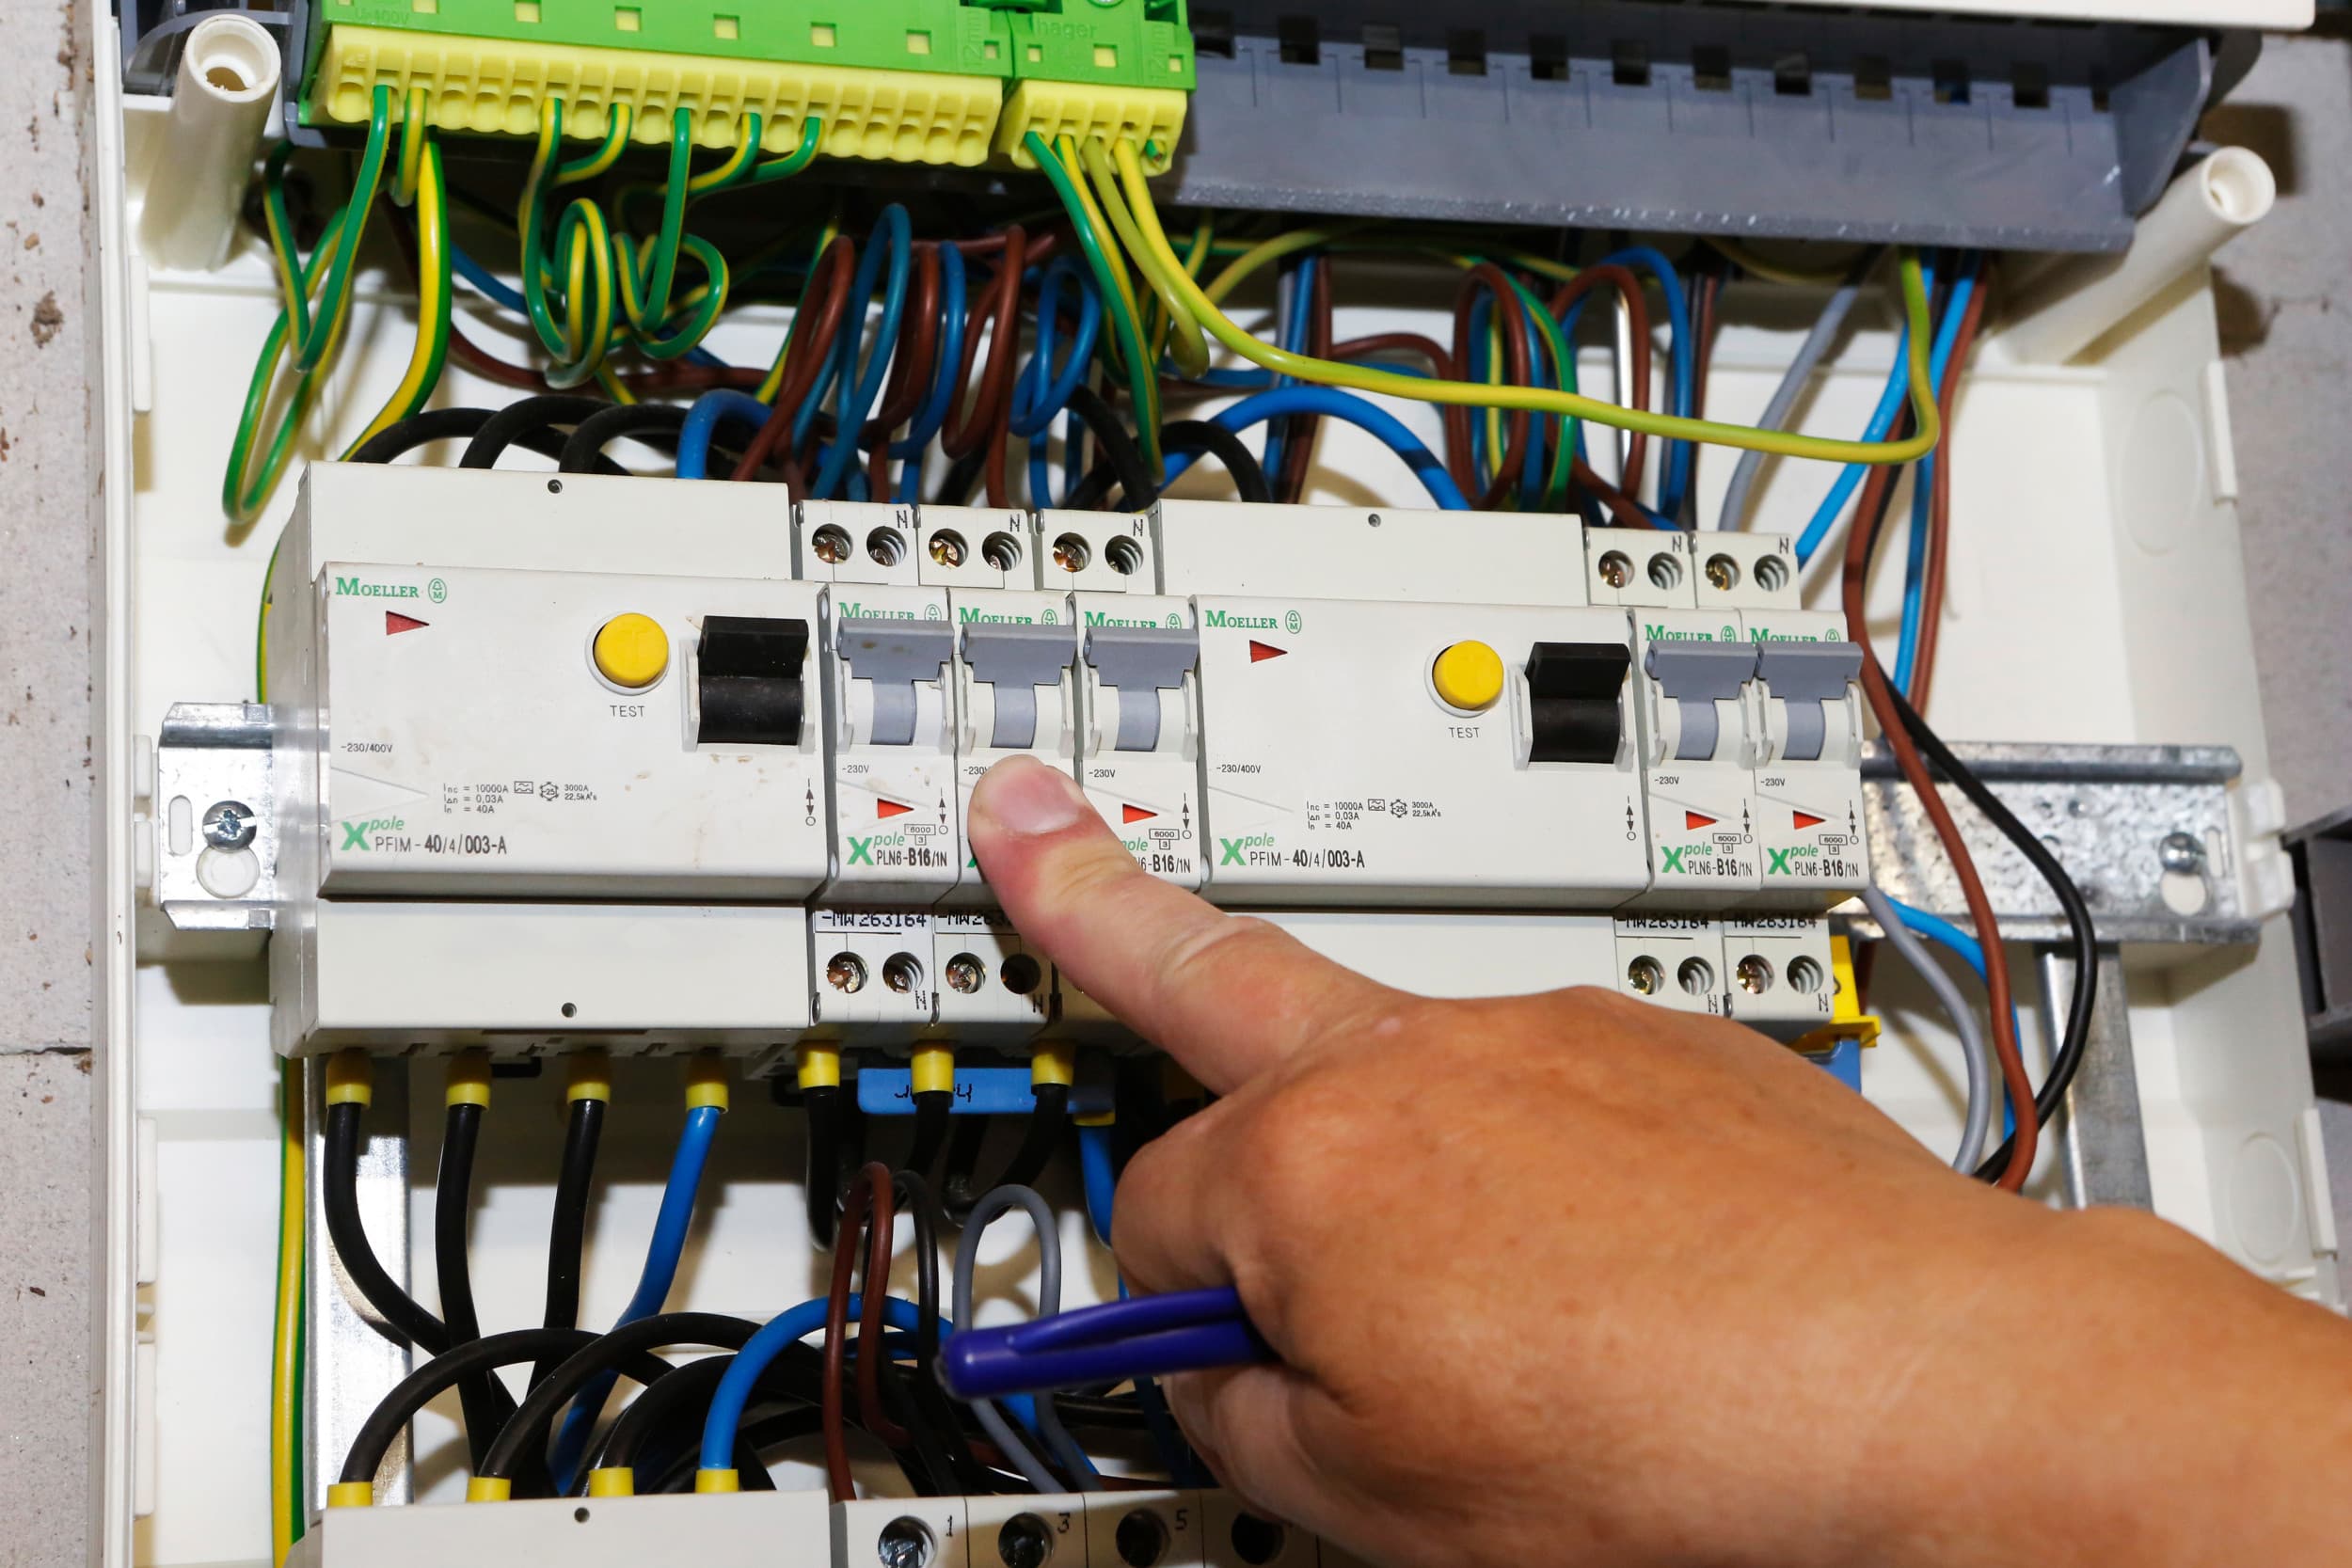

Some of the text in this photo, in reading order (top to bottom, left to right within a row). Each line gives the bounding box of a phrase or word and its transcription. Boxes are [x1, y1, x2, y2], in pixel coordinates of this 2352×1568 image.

[1037, 19, 1098, 40] hager
[897, 510, 908, 529] N
[1009, 514, 1020, 532] N
[1133, 518, 1143, 537] N
[1672, 535, 1682, 552] N
[1779, 537, 1789, 554] N
[335, 577, 420, 598] MOELLER
[1204, 610, 1279, 629] MOELLER
[610, 705, 645, 718] TEST
[1448, 727, 1480, 739] TEST
[476, 804, 495, 814] 40A
[1336, 821, 1352, 831] 40A
[914, 990, 927, 1010] N
[1708, 993, 1718, 1013] N
[1818, 992, 1829, 1012] N
[946, 1514, 953, 1537] 1
[1057, 1512, 1071, 1533] 3
[1175, 1509, 1188, 1529] 5
